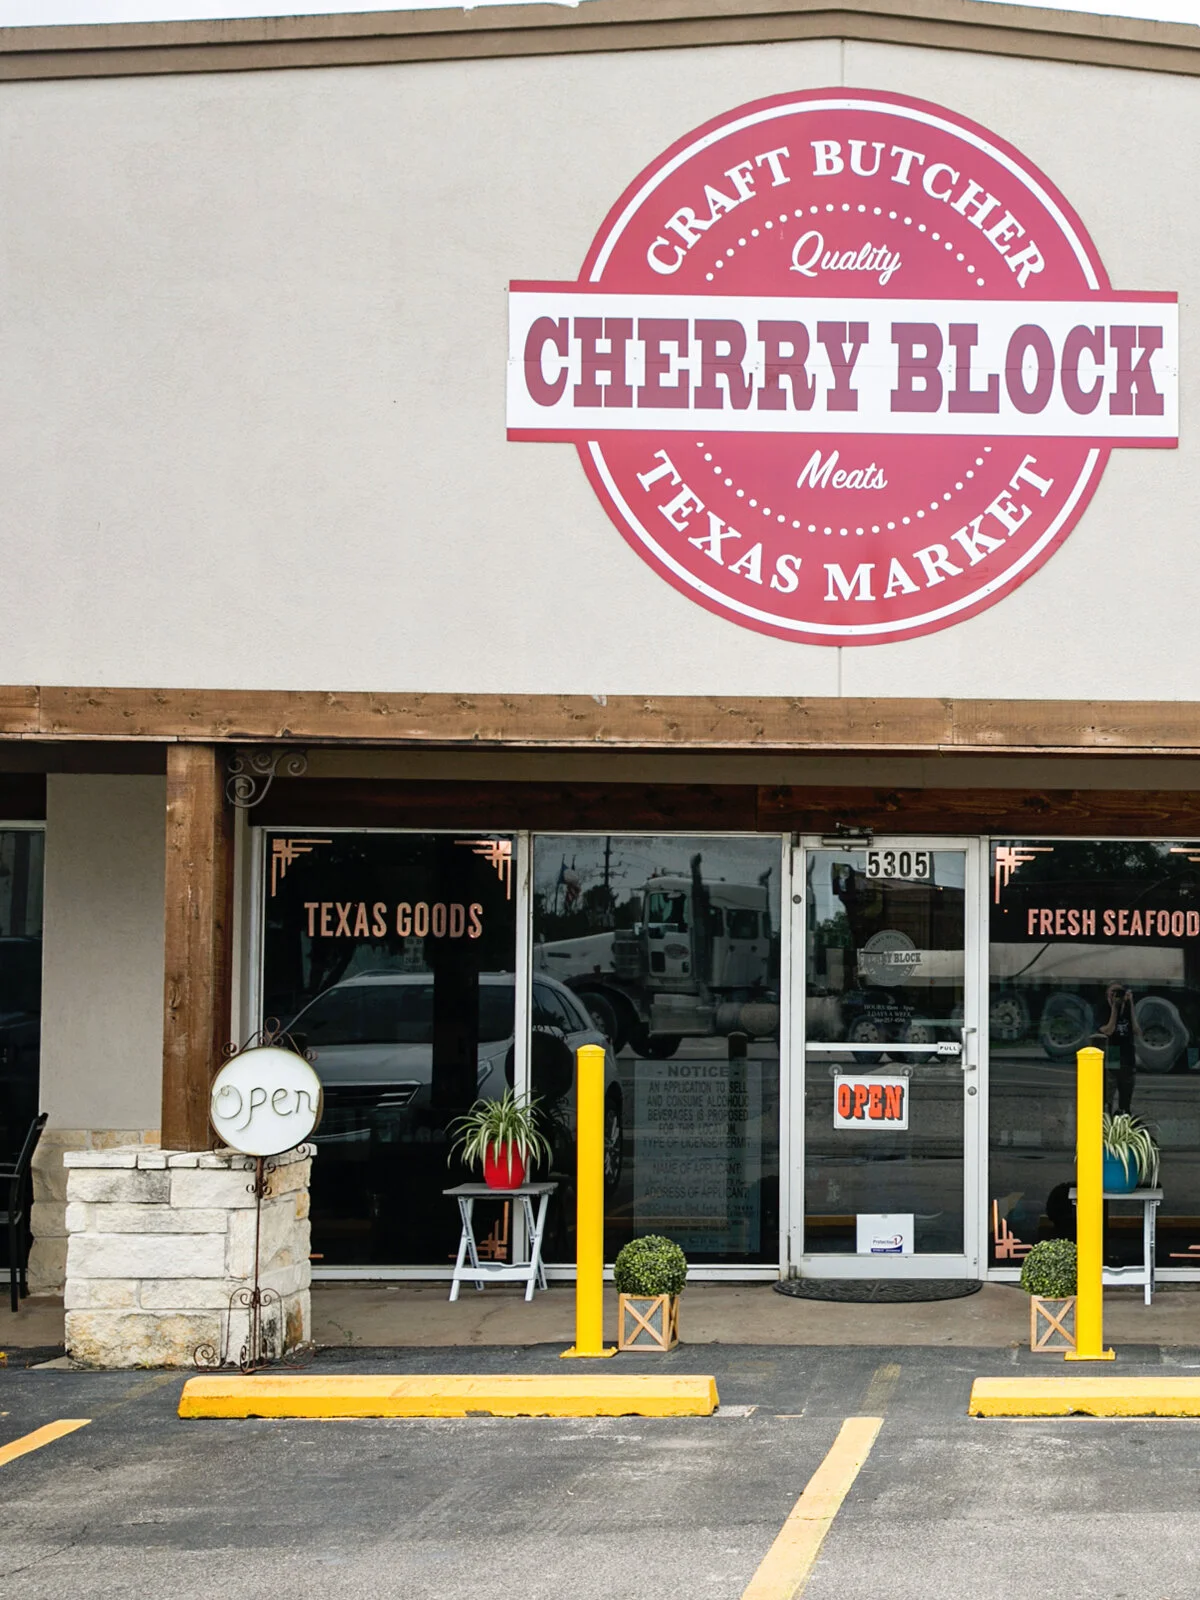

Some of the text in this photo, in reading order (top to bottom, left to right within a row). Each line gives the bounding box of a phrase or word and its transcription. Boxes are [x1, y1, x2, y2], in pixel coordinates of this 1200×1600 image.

[646, 139, 1045, 288] CRAFT BUTCHER
[790, 230, 902, 286] Quality
[523, 316, 1165, 416] CHERRY BLOCK
[796, 450, 888, 491] Meats
[636, 449, 1055, 601] TEXAS MARKET
[868, 851, 928, 877] 5305
[304, 902, 483, 939] TEXAS GOODS
[1027, 909, 1200, 937] FRESH SEAFOOD
[894, 953, 921, 963] BLOCK
[664, 1081, 712, 1094] APPLICATION
[729, 1081, 748, 1094] SELL
[667, 1066, 729, 1077] NOTICE
[213, 1085, 316, 1132] Open
[646, 1095, 662, 1108] AND
[647, 1108, 694, 1122] BEVERAGES
[838, 1083, 904, 1120] OPEN
